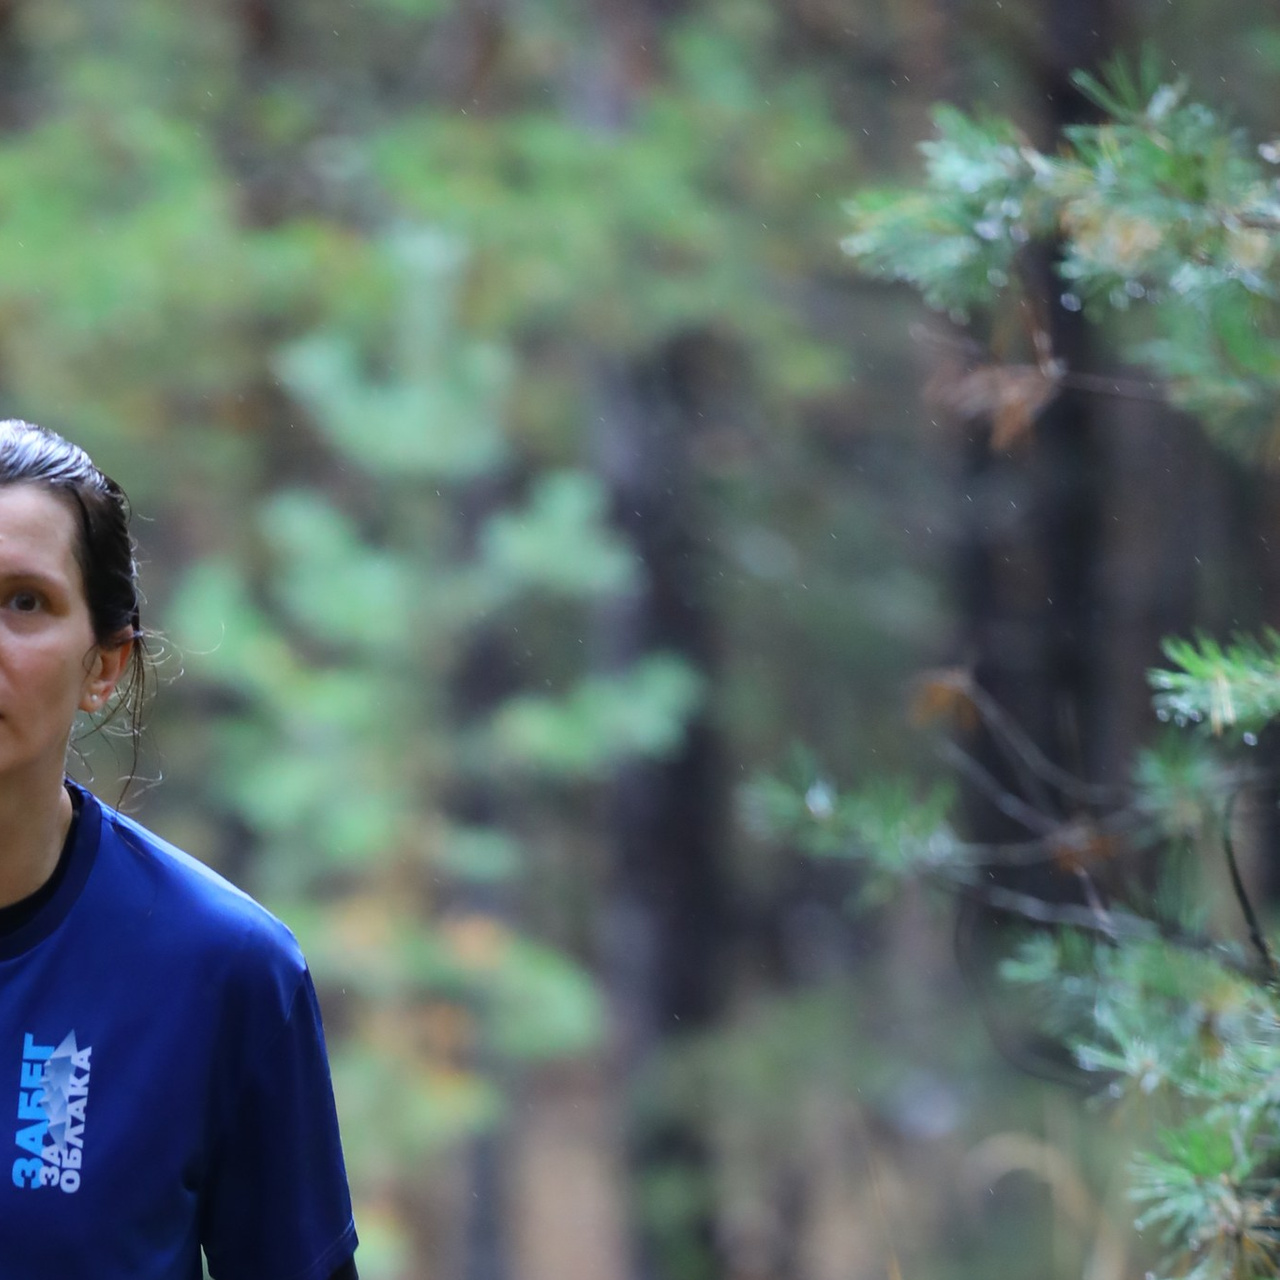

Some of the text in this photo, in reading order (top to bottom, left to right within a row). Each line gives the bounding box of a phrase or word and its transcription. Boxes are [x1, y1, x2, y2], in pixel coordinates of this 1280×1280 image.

[12, 1032, 54, 1190] ЗАБЕГ
[39, 1142, 61, 1188] ЗА
[60, 1046, 92, 1194] ОБЛАКА
